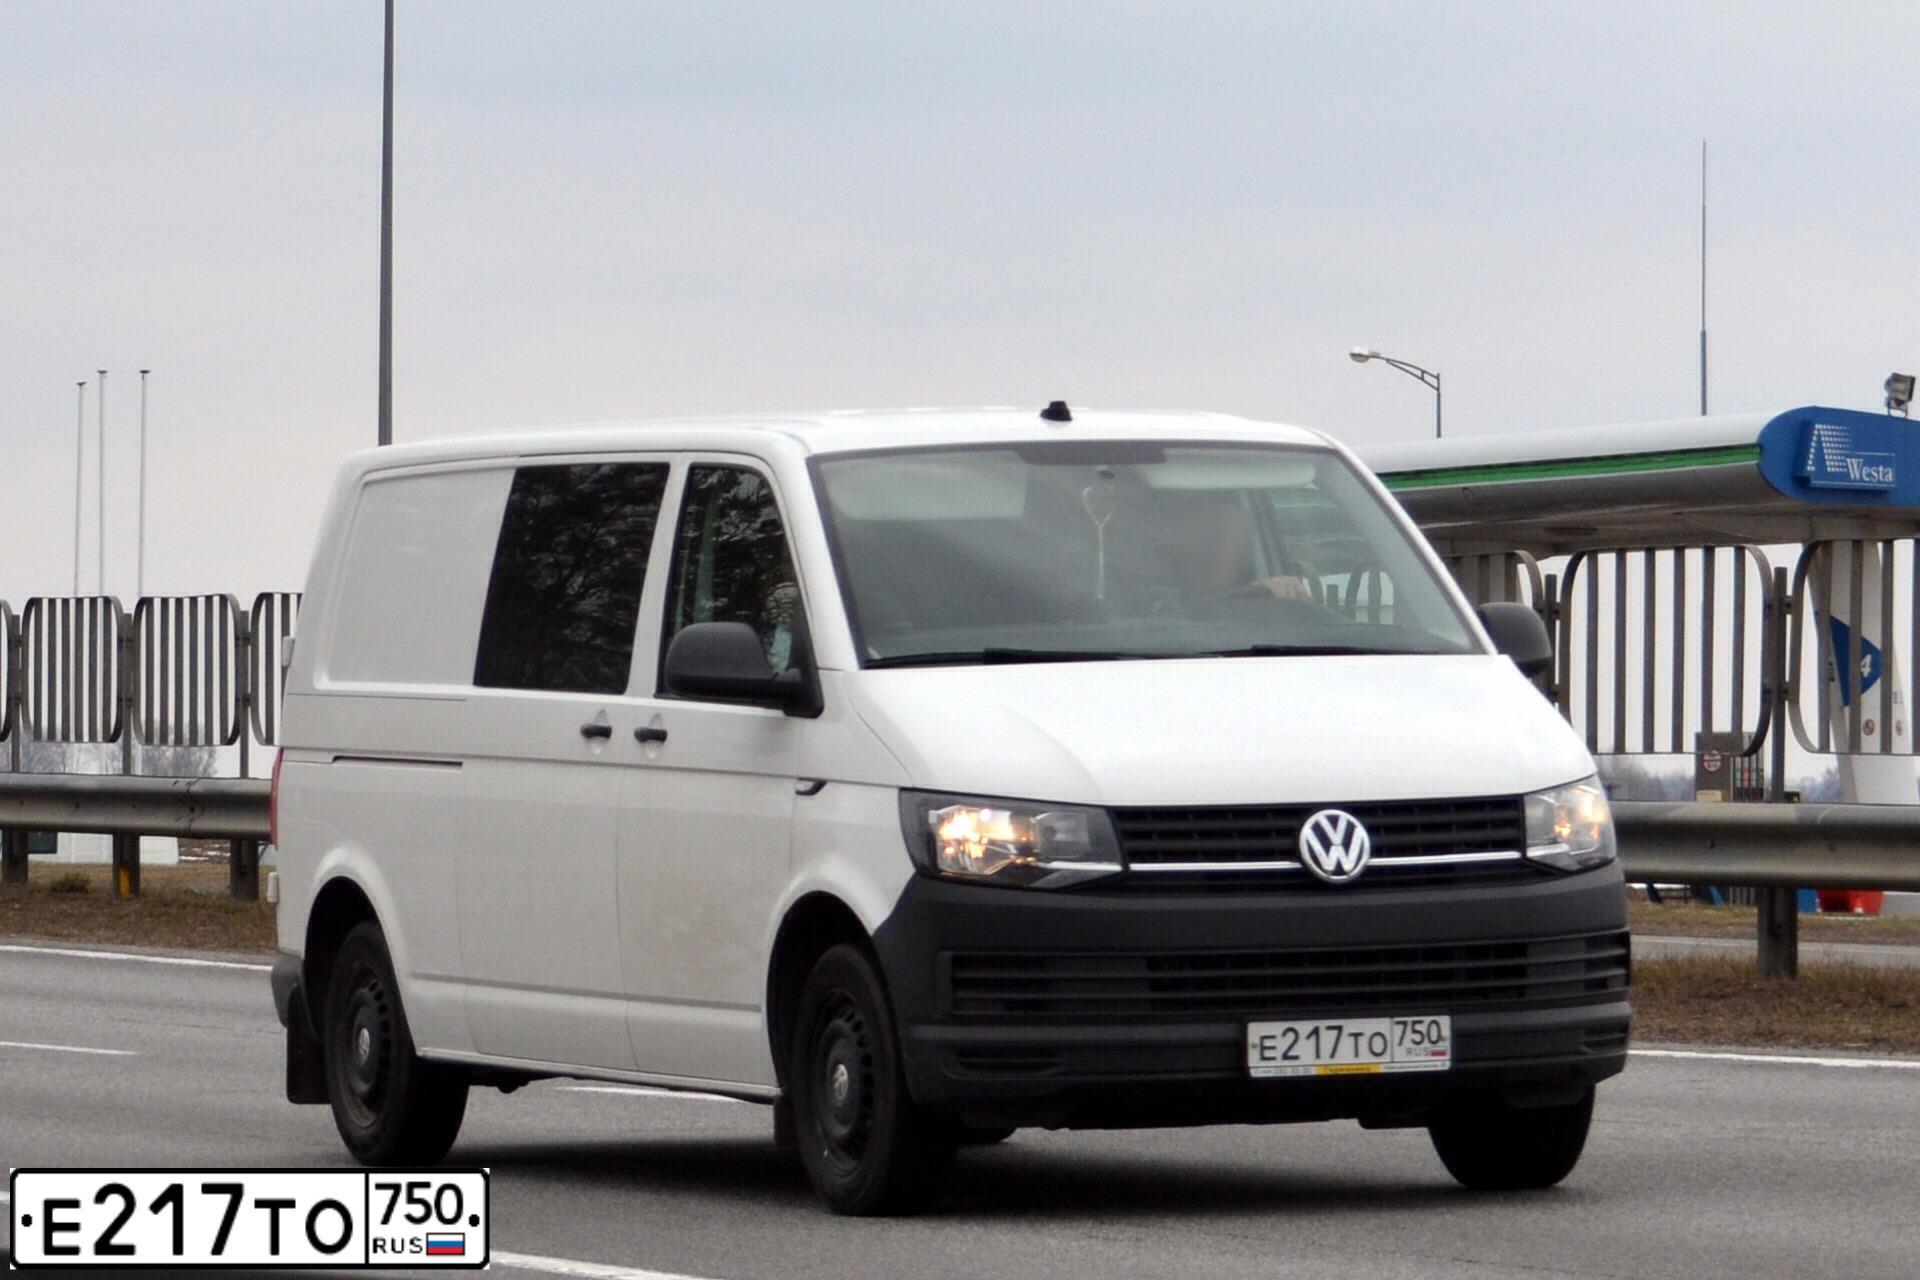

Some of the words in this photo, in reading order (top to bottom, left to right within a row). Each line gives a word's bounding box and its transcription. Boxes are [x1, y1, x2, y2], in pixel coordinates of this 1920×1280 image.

[1846, 457, 1894, 482] Westa
[1259, 1025, 1388, 1061] E217TO
[1395, 1019, 1442, 1046] 750
